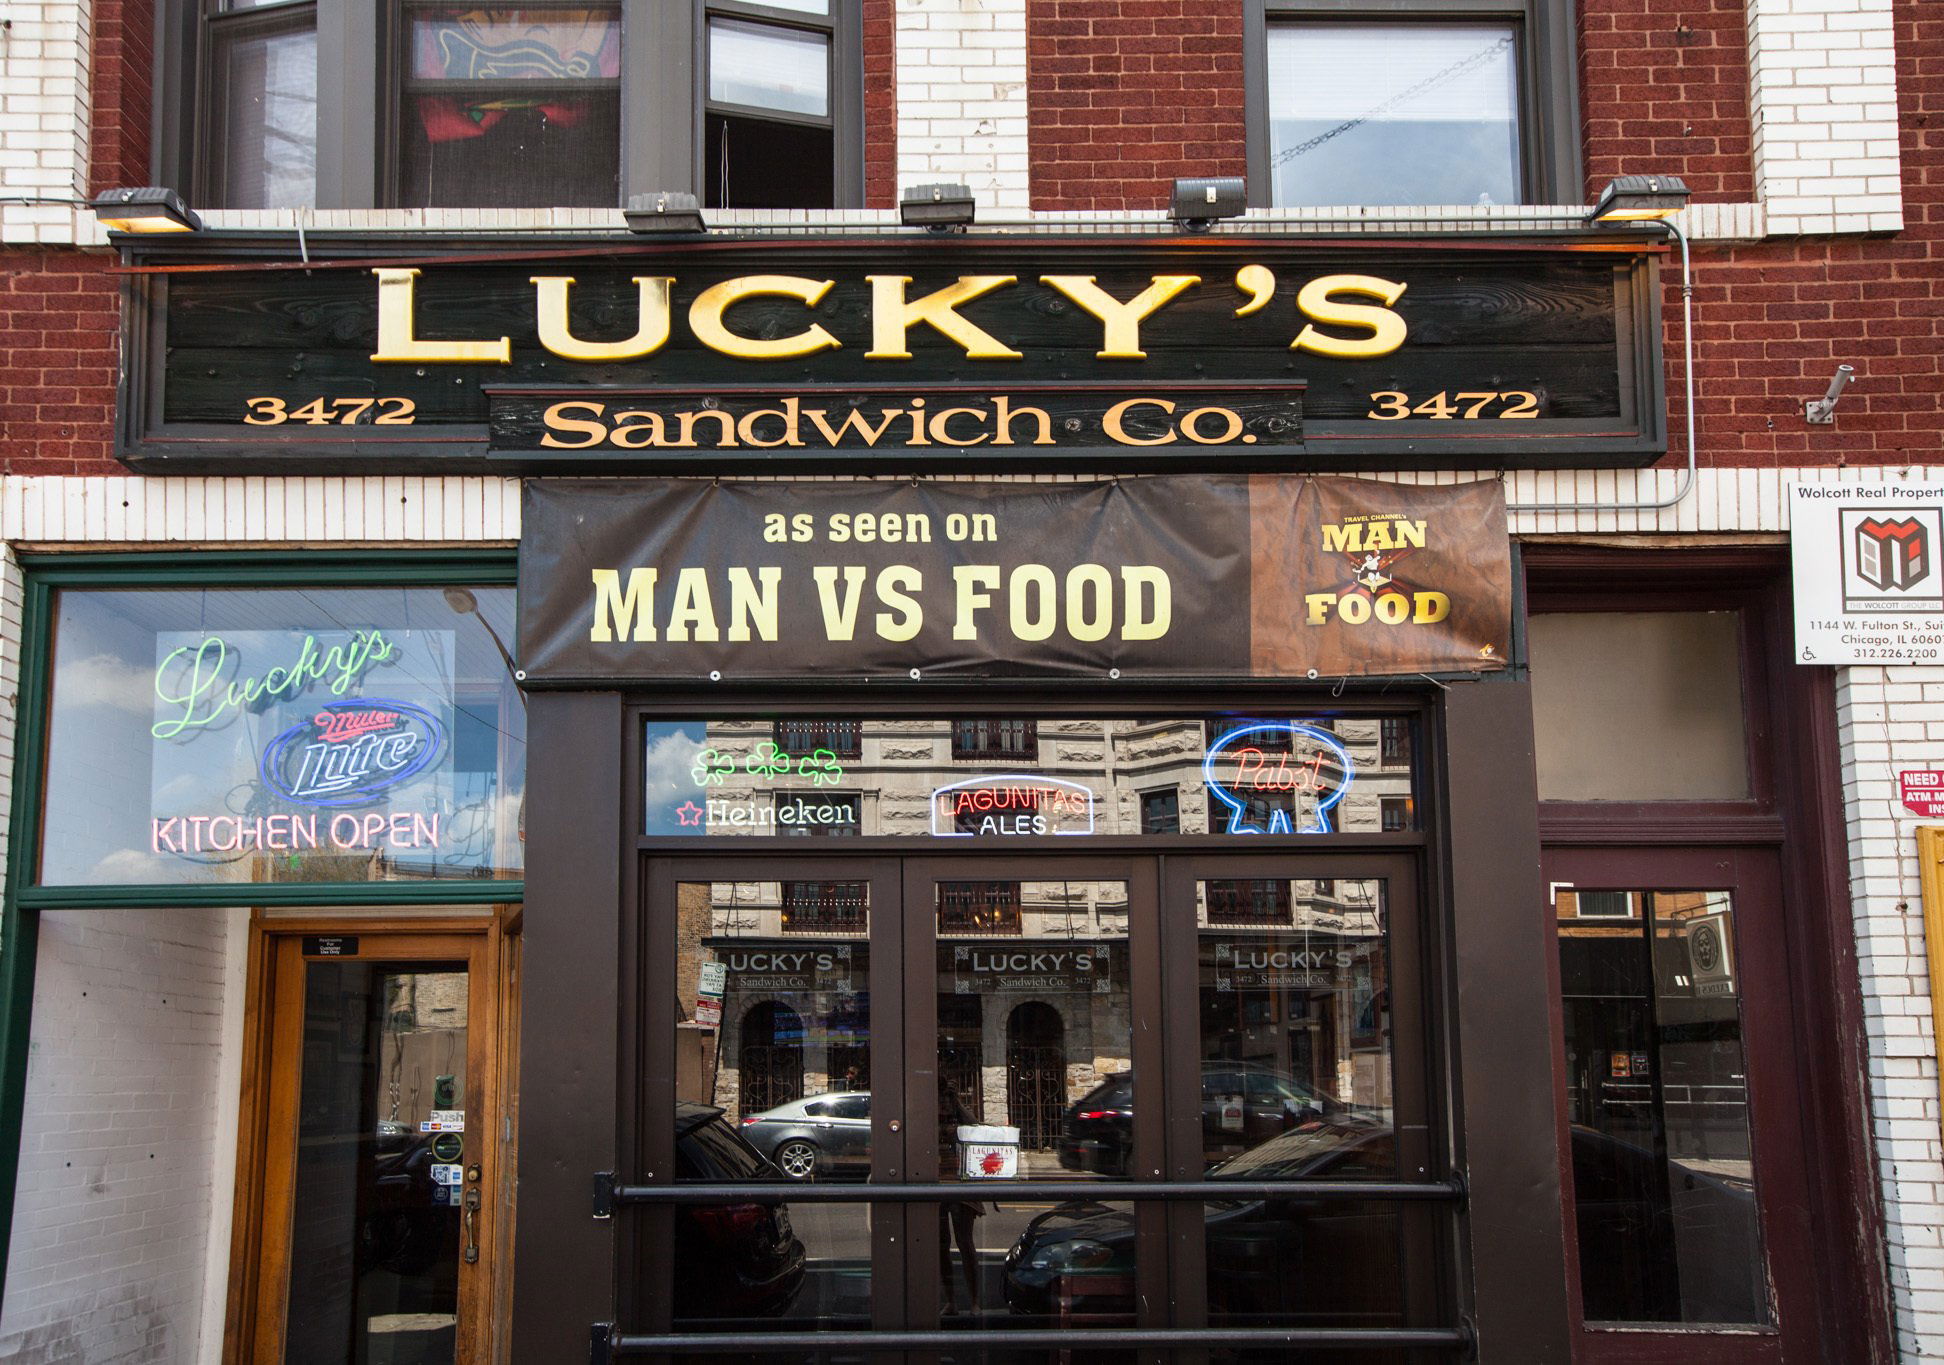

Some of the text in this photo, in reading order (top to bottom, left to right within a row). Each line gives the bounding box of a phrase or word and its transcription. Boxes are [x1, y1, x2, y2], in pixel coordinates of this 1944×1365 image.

[370, 265, 1408, 364] LUCKY'S
[242, 397, 416, 427] 3472
[1367, 390, 1540, 420] 3472
[541, 395, 1258, 449] Sandwich Co.
[1798, 486, 1851, 499] Wolcott
[1857, 486, 1887, 498] Real
[763, 512, 998, 543] as seen on
[1343, 515, 1369, 523] TRAVEL
[1321, 520, 1427, 552] MAN
[590, 563, 1173, 643] MAN VS FOOD
[1305, 591, 1451, 626] FOOD
[1810, 620, 1839, 631] 1144
[1843, 621, 1857, 630] W.
[1862, 620, 1898, 630] Fulton
[1902, 620, 1921, 632] St.,
[1841, 634, 1893, 646] Chicago,
[1897, 634, 1907, 644] IL
[1854, 648, 1937, 659] 312.226.2200
[151, 629, 393, 739] Lucky's
[314, 710, 400, 740] Miller
[290, 732, 417, 795] Lite
[1230, 747, 1331, 791] Pabst
[1903, 773, 1939, 786] NEED
[940, 785, 1085, 816] LAGUNITAS
[1906, 791, 1931, 801] ATM
[705, 798, 855, 827] Heineken
[980, 815, 1047, 836] ALES
[151, 812, 441, 854] KITCHEN OPEN
[973, 951, 1092, 972] LUCKY'S
[1234, 950, 1352, 969] LUCKY'S
[740, 976, 787, 987] Sandwich
[789, 977, 806, 987] Co.
[1000, 976, 1066, 987] Sandwich Co.
[1261, 974, 1326, 985] Sandwich Co.
[432, 1111, 464, 1122] Push
